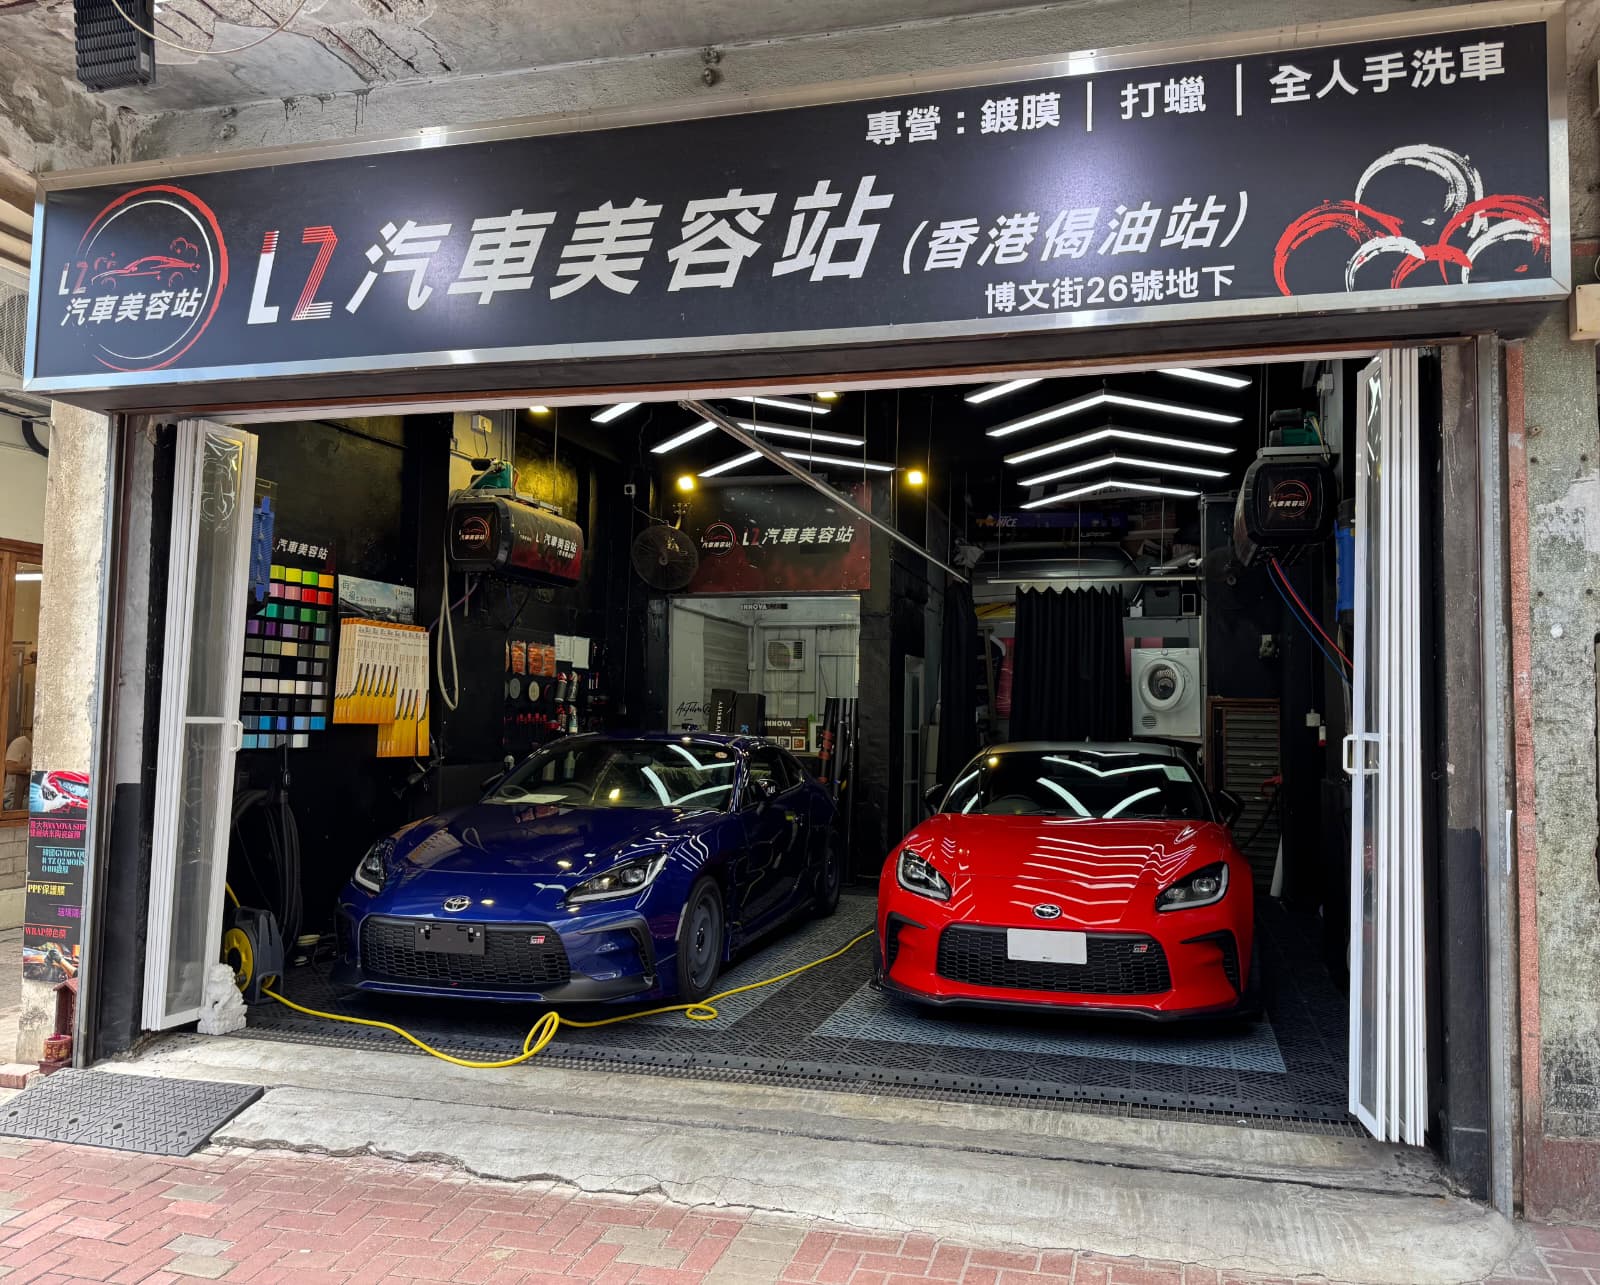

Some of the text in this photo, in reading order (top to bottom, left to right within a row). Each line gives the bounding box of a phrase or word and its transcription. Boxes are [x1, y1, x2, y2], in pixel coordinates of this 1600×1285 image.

[1120, 74, 1207, 120] 打蠟
[1268, 41, 1505, 104] 全人手洗車
[345, 174, 894, 313] 汽車美容站
[60, 289, 204, 327] 汽車美容站
[984, 264, 1236, 315] 博文街26號地下
[276, 538, 329, 560] 汽車美容站
[761, 525, 855, 545] 汽車美容站
